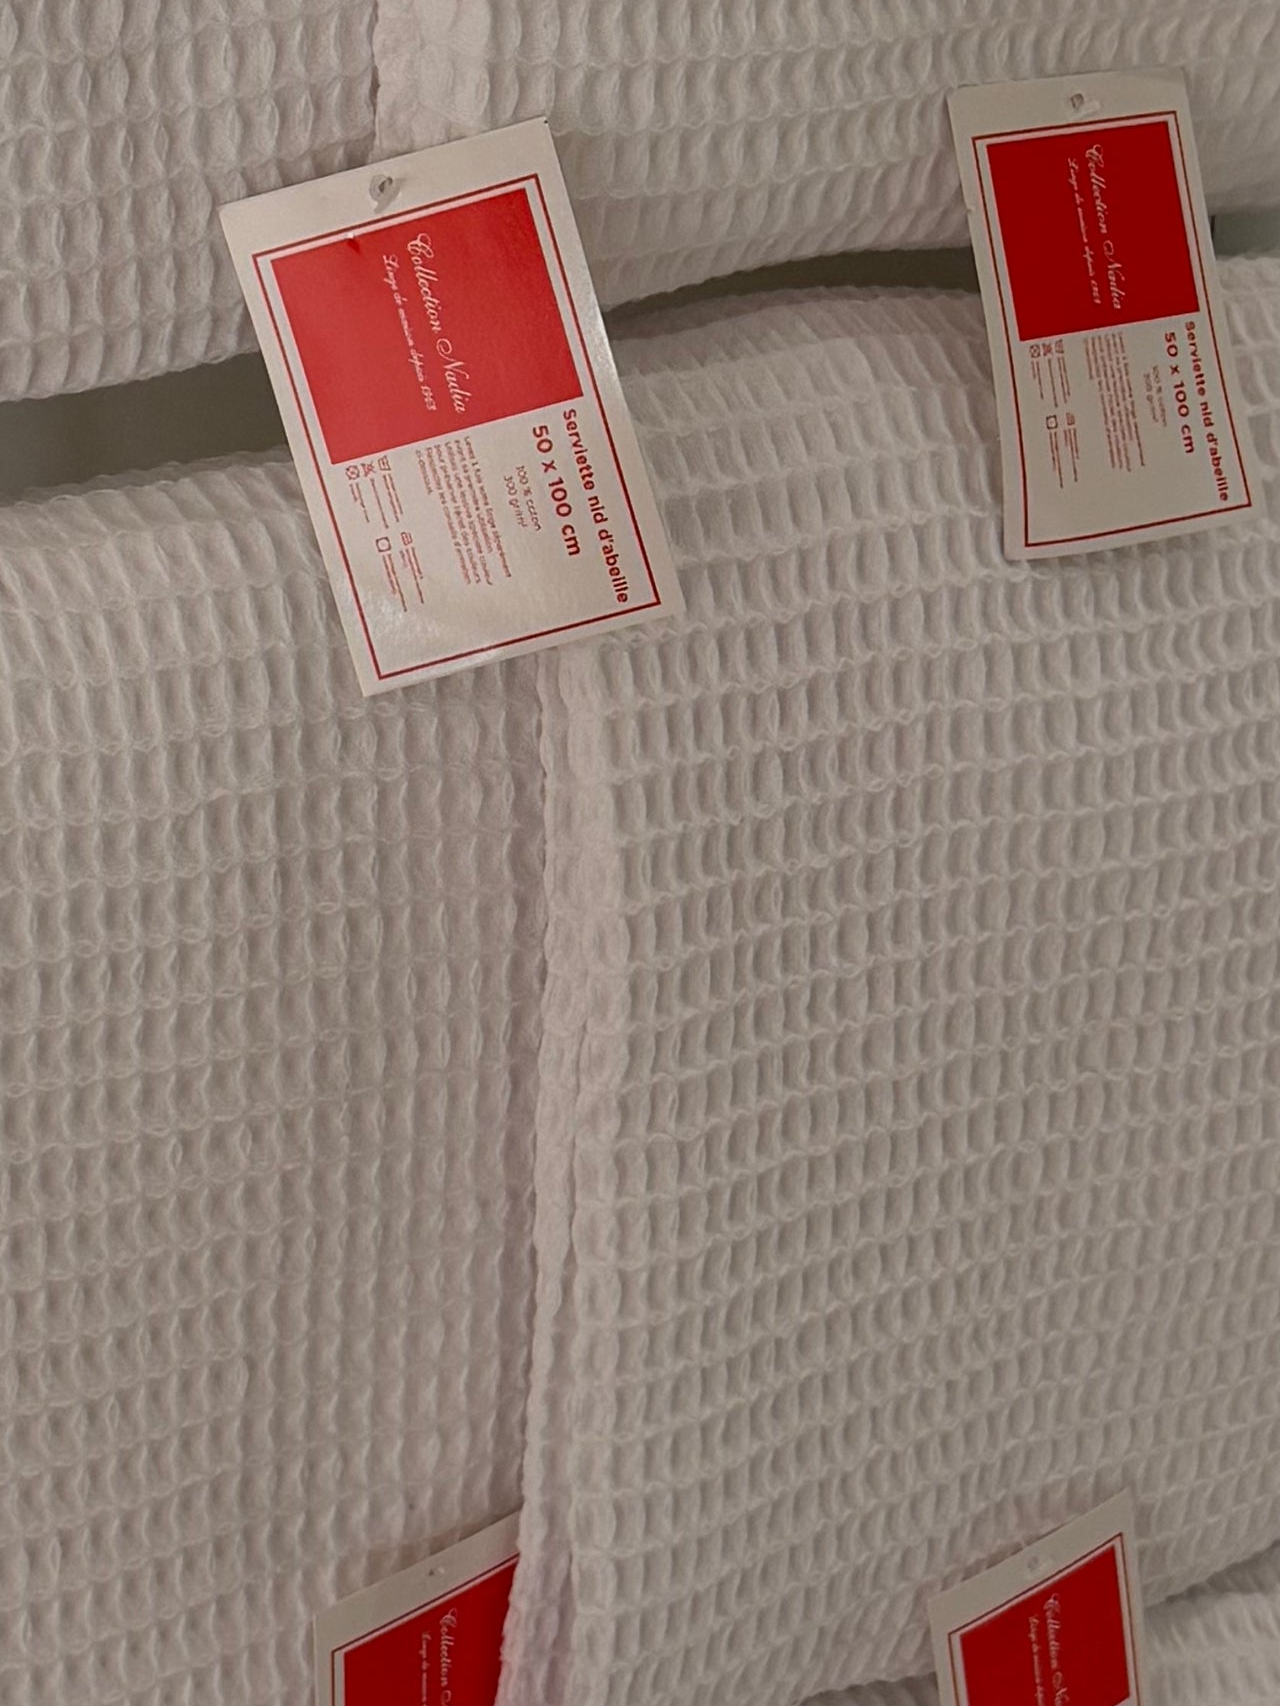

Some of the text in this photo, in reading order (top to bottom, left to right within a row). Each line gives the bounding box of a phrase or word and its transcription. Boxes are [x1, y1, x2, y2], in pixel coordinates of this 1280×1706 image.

[1085, 144, 1126, 310] Collection Nadia
[406, 233, 472, 413] Collection Nadia
[1164, 331, 1195, 454] 50 x 100 cm
[532, 424, 581, 556] 50 x 100 cm
[1185, 320, 1229, 502] Serviette nid d'abeille
[562, 408, 629, 603] Serviette nid d'abeille
